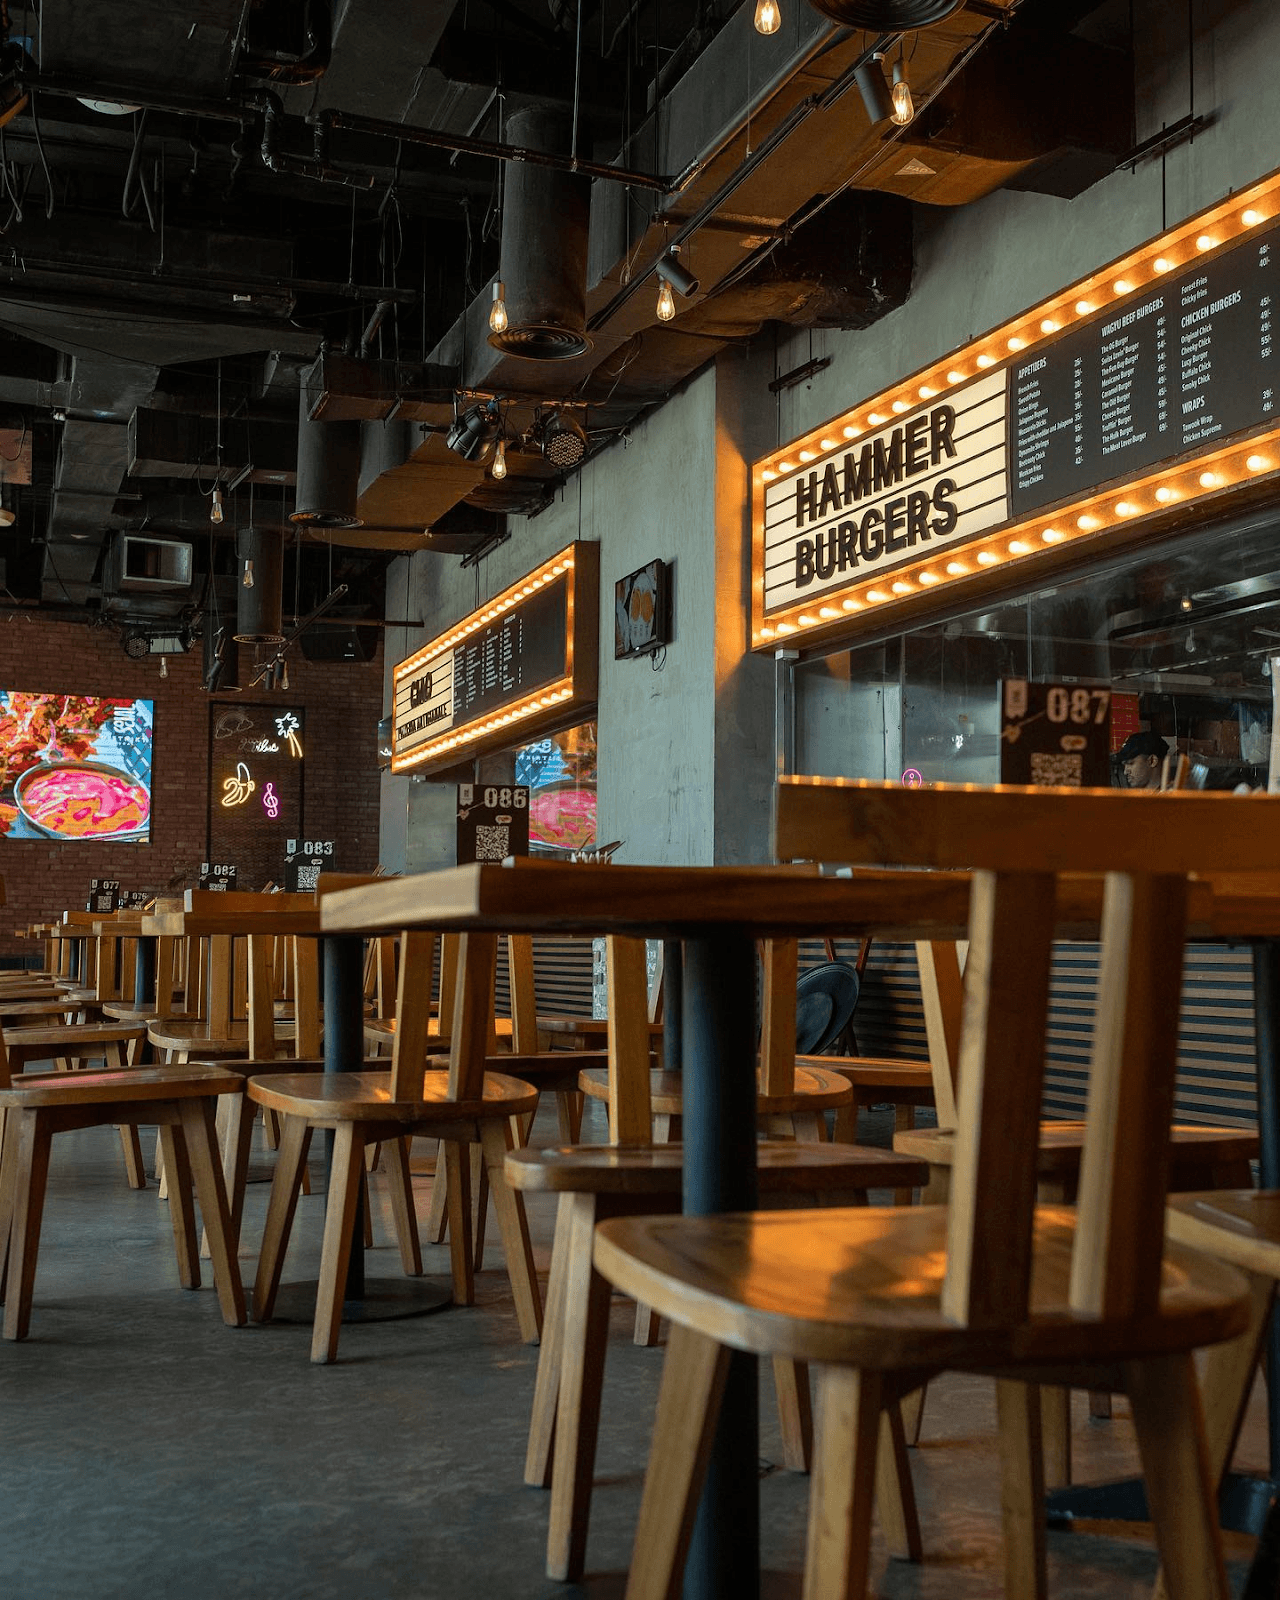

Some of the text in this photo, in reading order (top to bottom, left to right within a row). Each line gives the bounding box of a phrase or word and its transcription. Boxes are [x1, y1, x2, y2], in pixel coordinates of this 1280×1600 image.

[1196, 276, 1208, 288] Fries
[1181, 289, 1242, 328] CHICKEN BURGERS
[1101, 296, 1164, 337] WAGYU BEEF BURGERS
[1181, 323, 1213, 344] Original Chick
[1115, 336, 1129, 348] Burger
[1125, 342, 1140, 353] Burger
[1198, 336, 1212, 348] Chick
[1124, 354, 1139, 366] Burger
[1192, 351, 1208, 363] Burger
[1018, 357, 1047, 380] APPETIZERS
[1120, 366, 1135, 378] Burger
[1198, 361, 1212, 372] Chick
[1197, 373, 1211, 385] Chick
[1118, 380, 1133, 391] Burger
[1116, 392, 1131, 403] Burger
[1116, 404, 1131, 415] Burger
[1182, 395, 1205, 414] WRAPS
[1117, 415, 1132, 426] Burger
[1119, 425, 1134, 437] Burger
[1183, 430, 1201, 444] Chicken
[1132, 432, 1147, 443] Burger
[796, 404, 959, 528] HAMMER
[795, 477, 959, 588] BURGERS
[1047, 688, 1110, 724] 087
[484, 787, 527, 808] 086
[304, 841, 333, 855] 083
[213, 864, 236, 876] 082
[103, 881, 120, 890] 077
